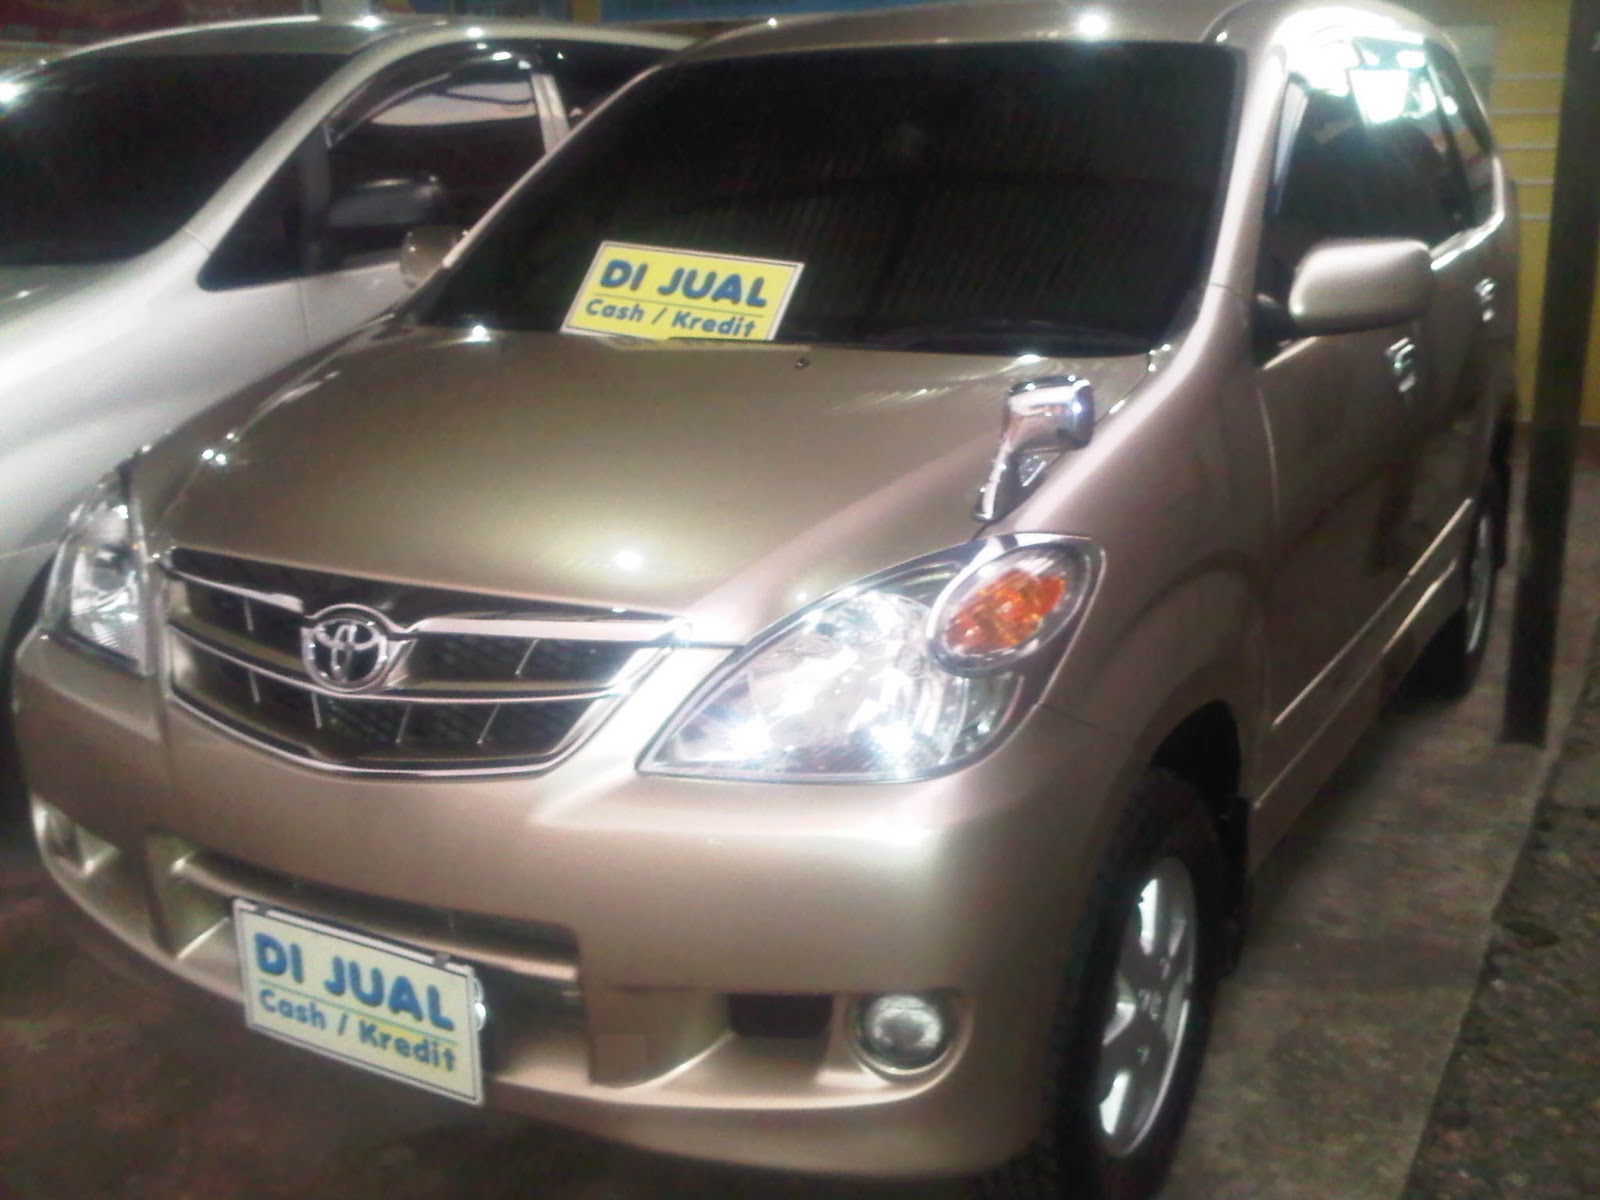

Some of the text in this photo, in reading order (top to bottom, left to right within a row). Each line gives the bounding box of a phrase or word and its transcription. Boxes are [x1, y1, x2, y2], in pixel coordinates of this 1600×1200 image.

[600, 259, 767, 308] DI JUAL
[586, 299, 756, 338] Cash / Kredit
[254, 932, 455, 1031] DI JUAL
[259, 988, 456, 1072] Cash / Kredit
